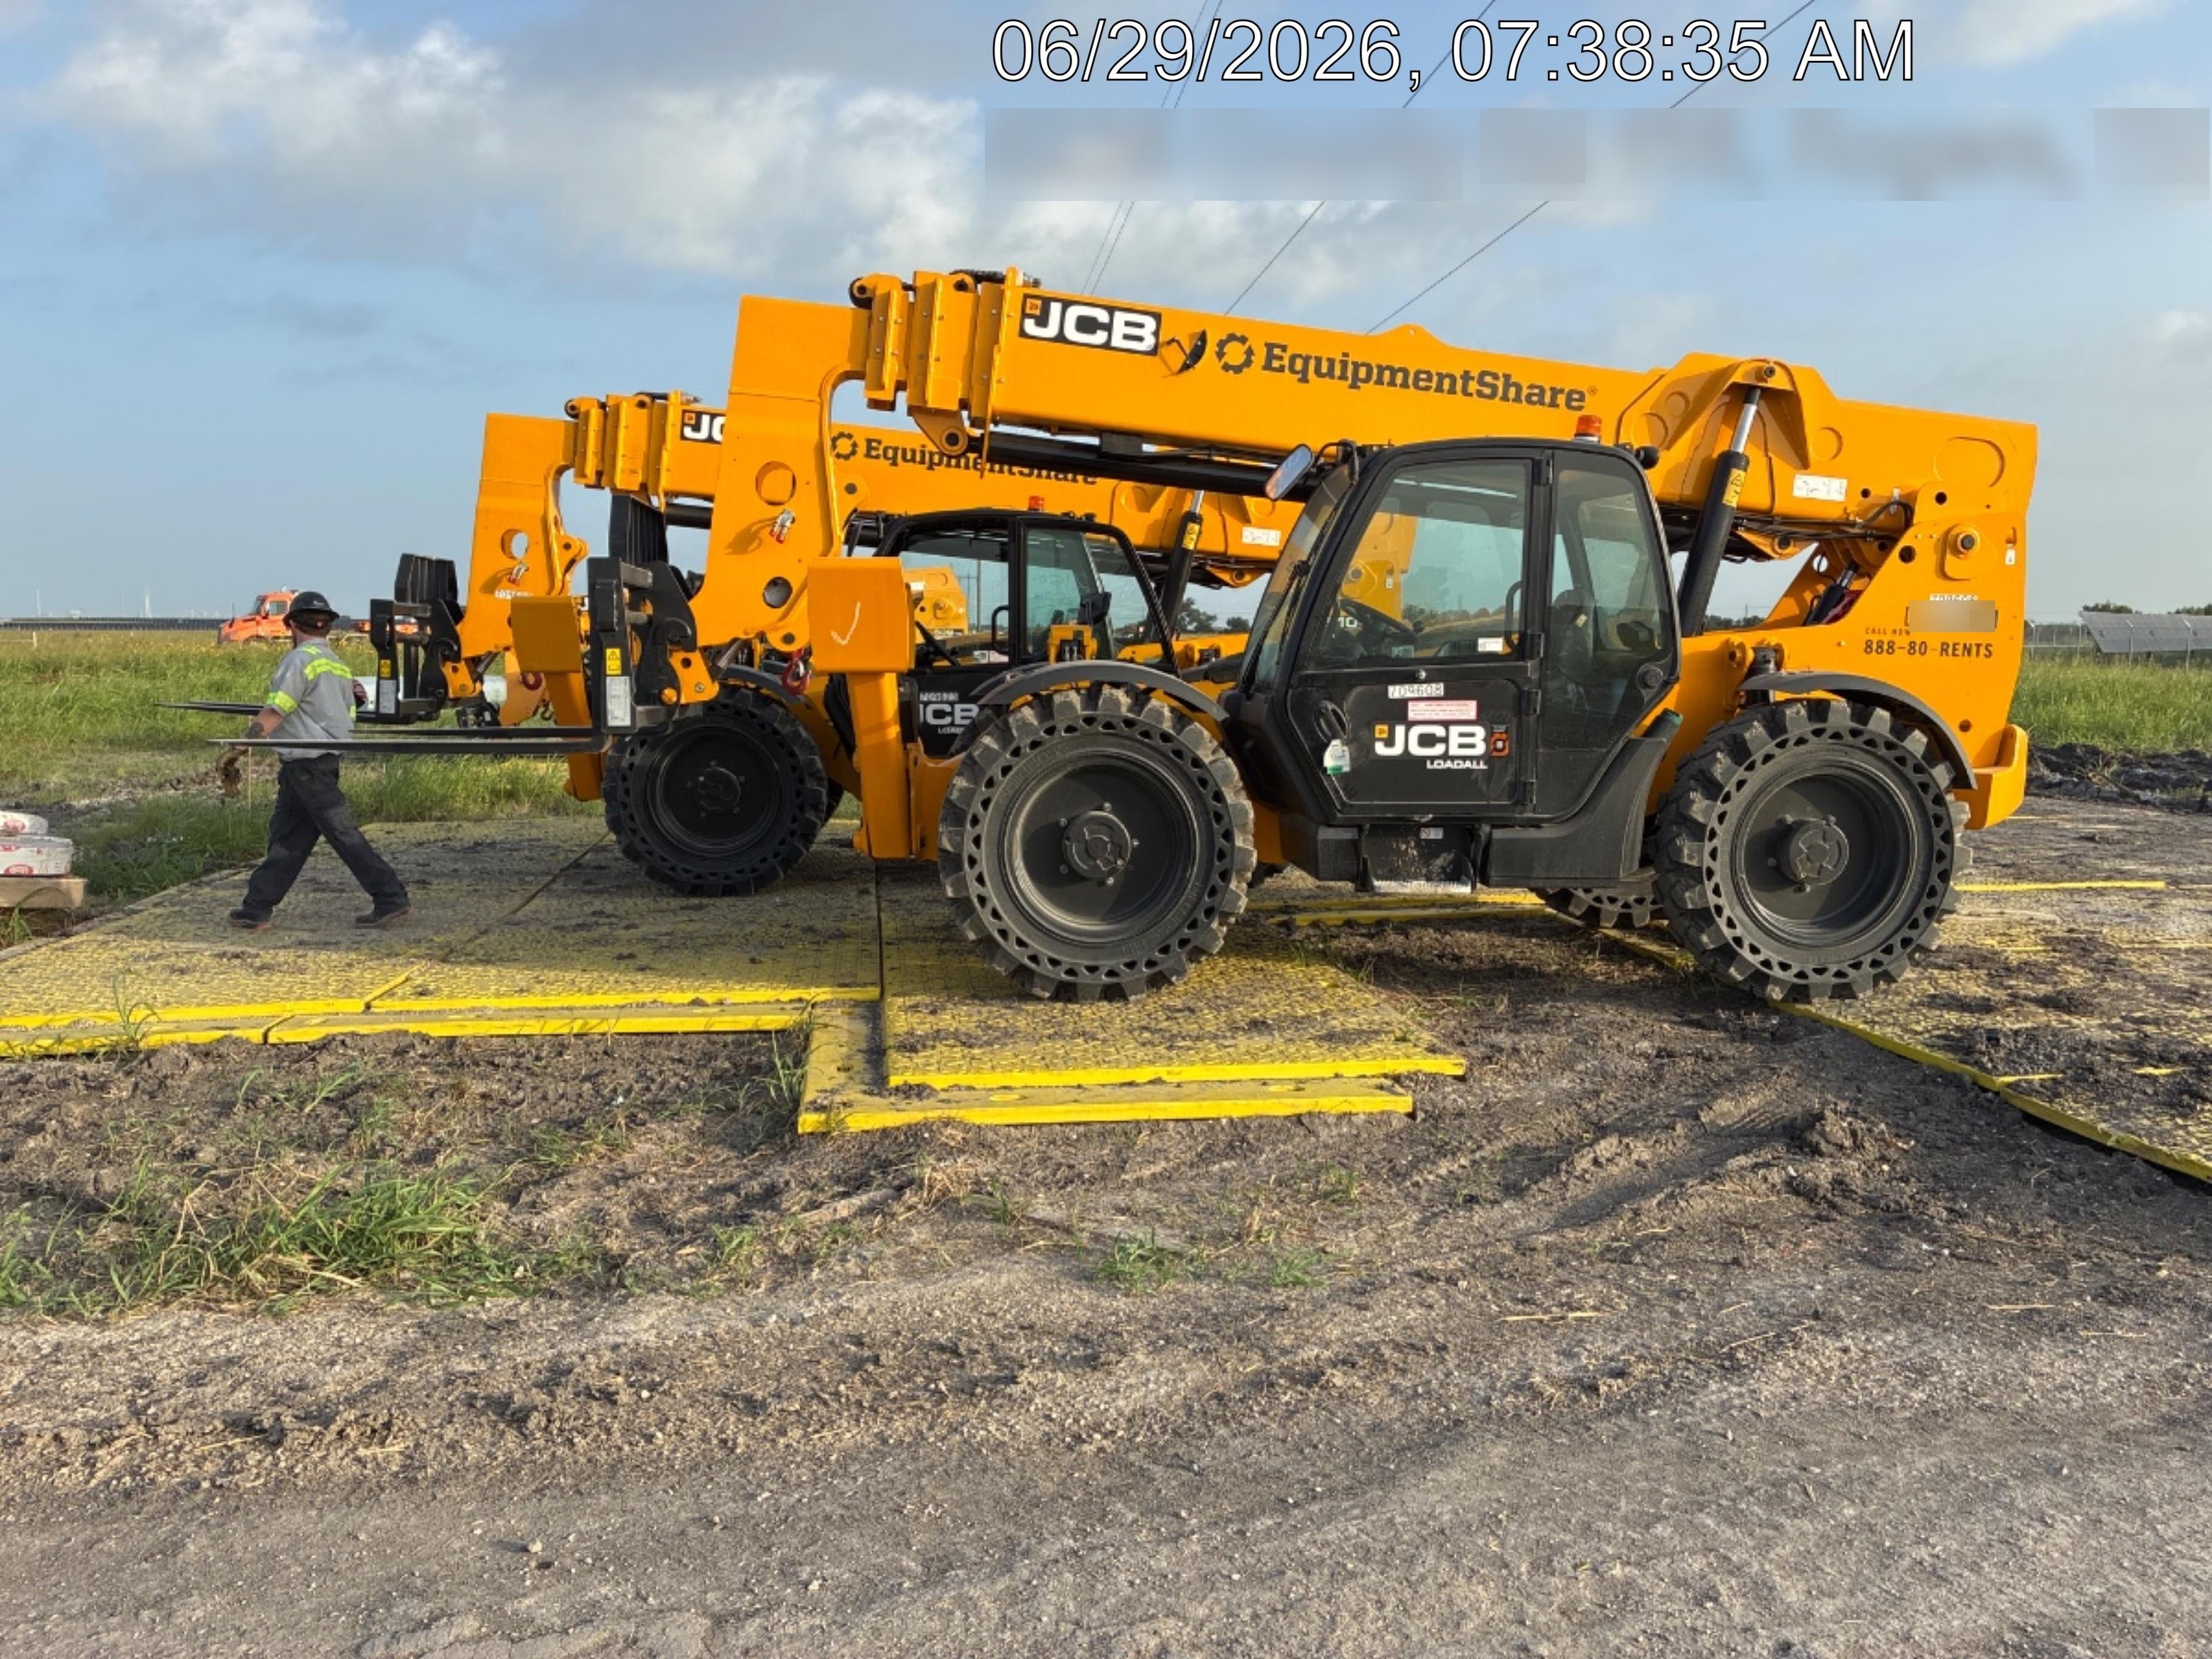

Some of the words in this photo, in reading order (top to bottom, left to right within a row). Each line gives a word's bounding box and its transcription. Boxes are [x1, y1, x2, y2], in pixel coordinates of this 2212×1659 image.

[1023, 302, 1156, 351] JCB
[1261, 342, 1586, 411] EquipmentShare
[919, 703, 979, 725] CB
[1375, 724, 1486, 756] JCB
[1426, 759, 1488, 769] LOADALL
